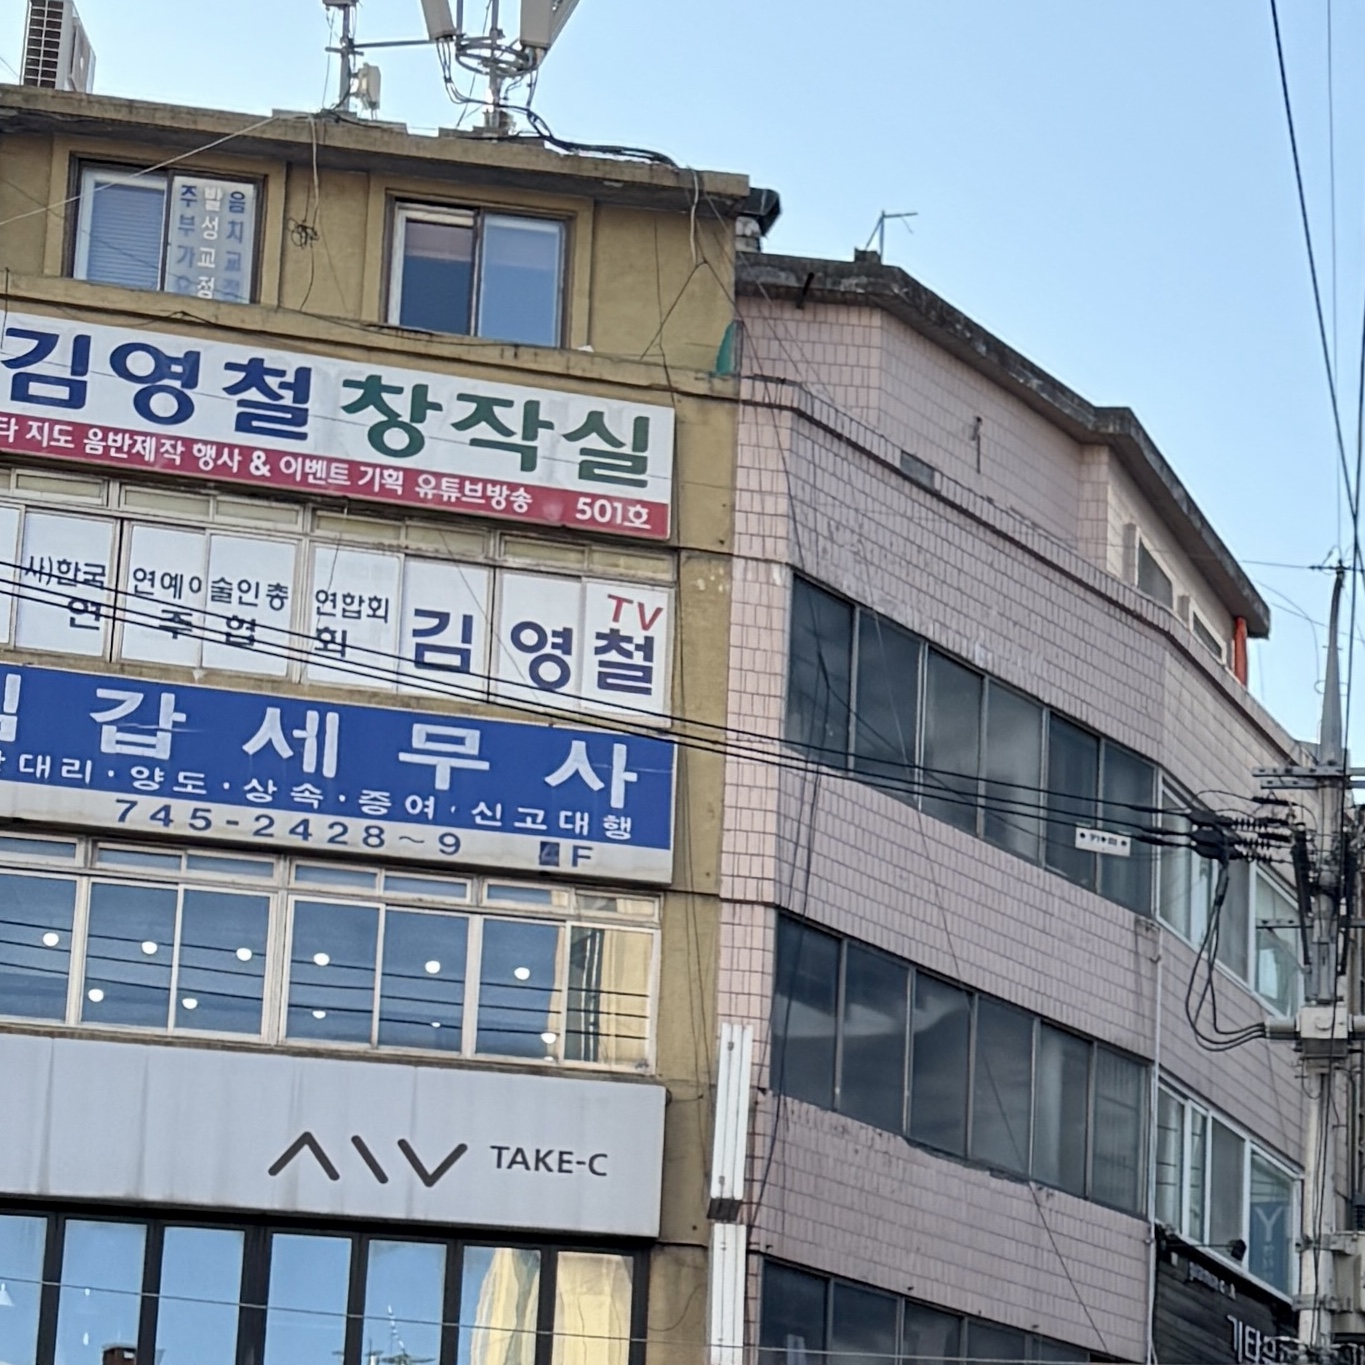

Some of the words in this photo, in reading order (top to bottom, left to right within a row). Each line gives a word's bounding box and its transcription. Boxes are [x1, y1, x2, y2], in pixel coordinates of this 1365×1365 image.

[25, 420, 75, 448] 지도
[83, 428, 184, 465] 음반제작
[192, 442, 242, 473] 행사
[252, 451, 271, 477] &
[279, 457, 351, 485] 이벤트
[358, 467, 404, 495] 기획
[415, 475, 532, 513] 유튜브방송
[575, 497, 651, 530] 501호
[607, 594, 664, 631] TV
[412, 608, 655, 696] 김영철
[490, 1145, 608, 1177] TAKE-C
